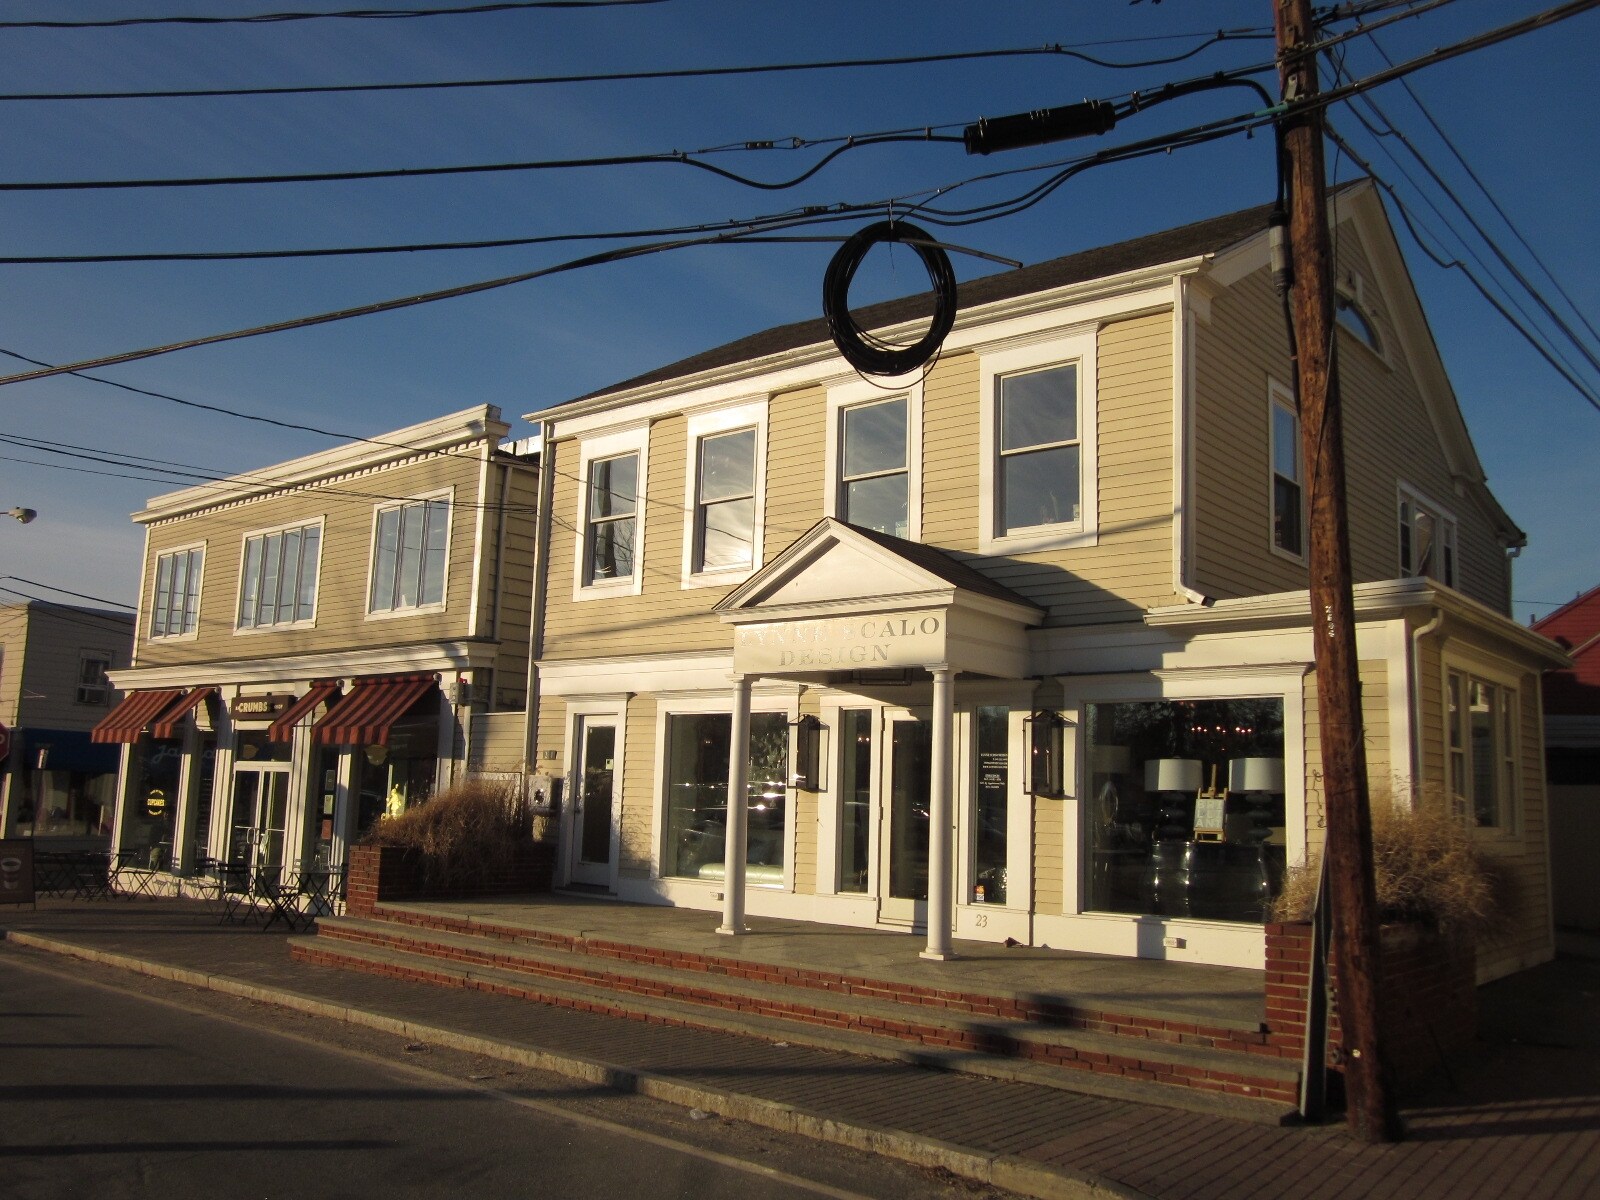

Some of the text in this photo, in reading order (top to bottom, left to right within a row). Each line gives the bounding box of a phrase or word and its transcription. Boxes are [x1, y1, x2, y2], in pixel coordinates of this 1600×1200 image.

[842, 616, 940, 641] SCALO
[778, 643, 892, 667] DESIGN
[239, 701, 267, 713] CRUMBS
[975, 914, 988, 928] 23
